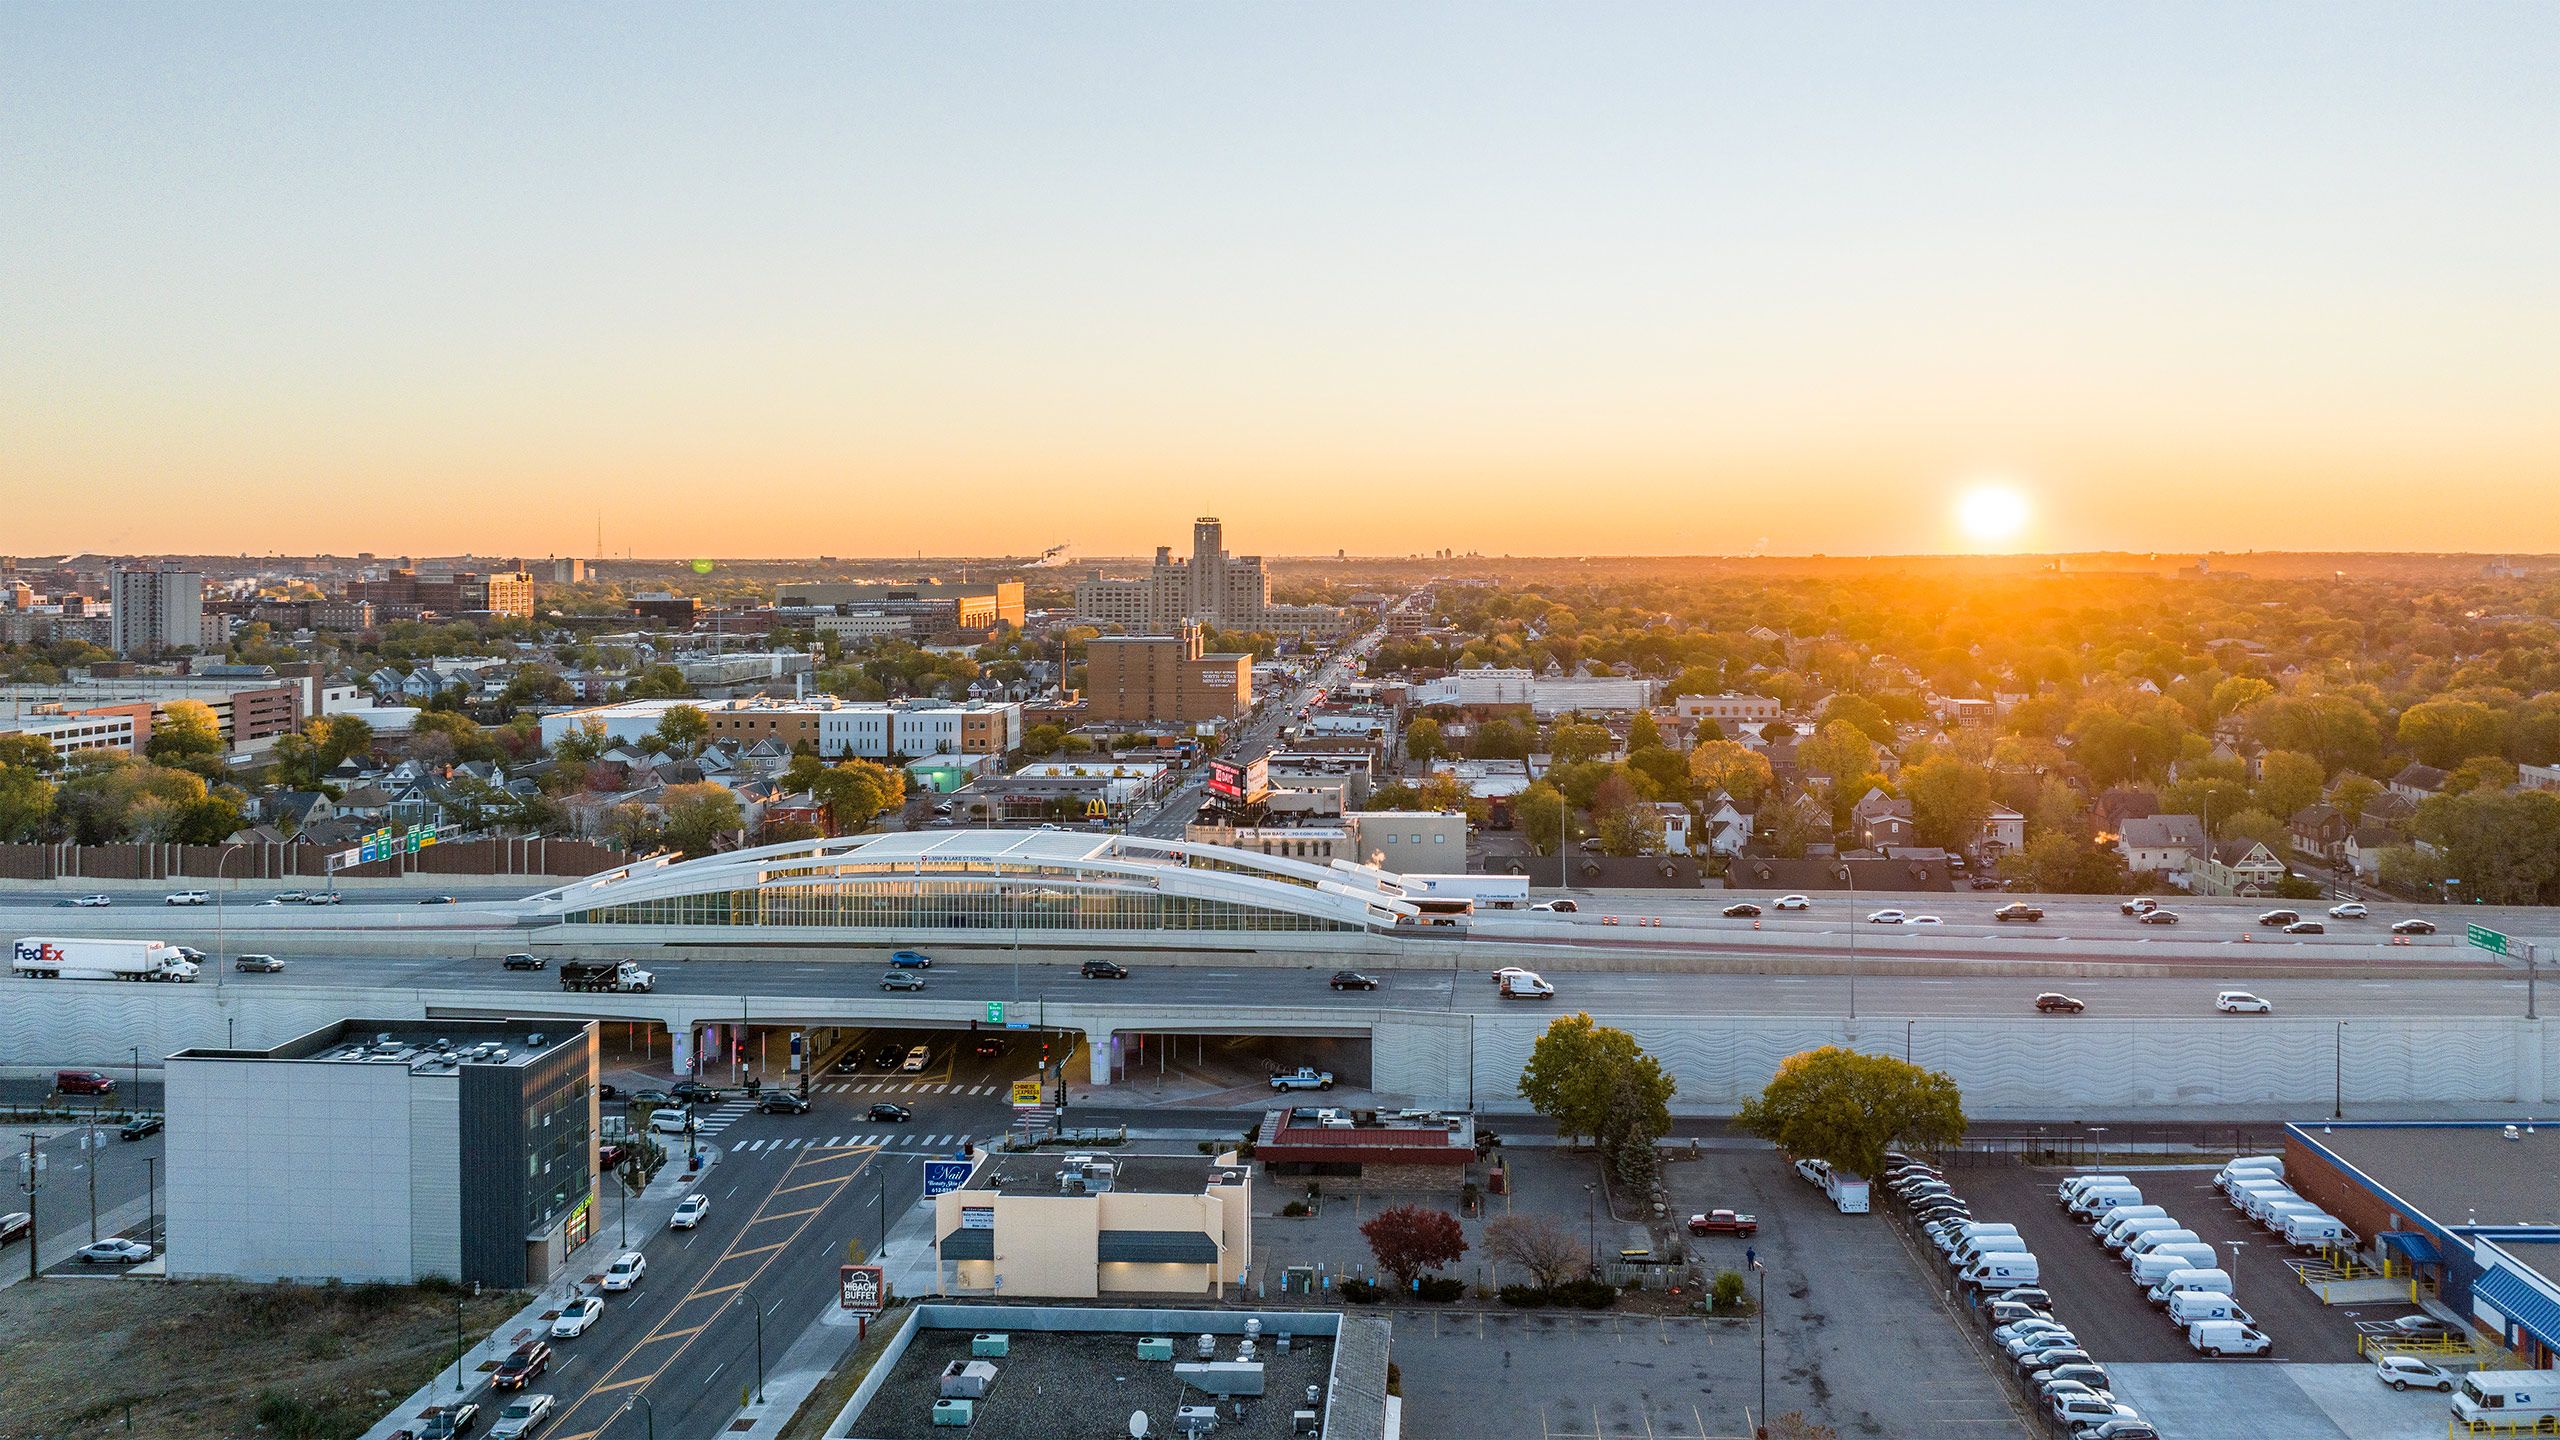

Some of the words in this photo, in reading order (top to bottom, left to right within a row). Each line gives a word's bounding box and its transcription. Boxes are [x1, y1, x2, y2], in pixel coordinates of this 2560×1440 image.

[15, 942, 64, 961] FedEx
[932, 1165, 965, 1180] Nail
[843, 1281, 879, 1293] HIBACHI
[844, 1291, 876, 1300] BUFFET
